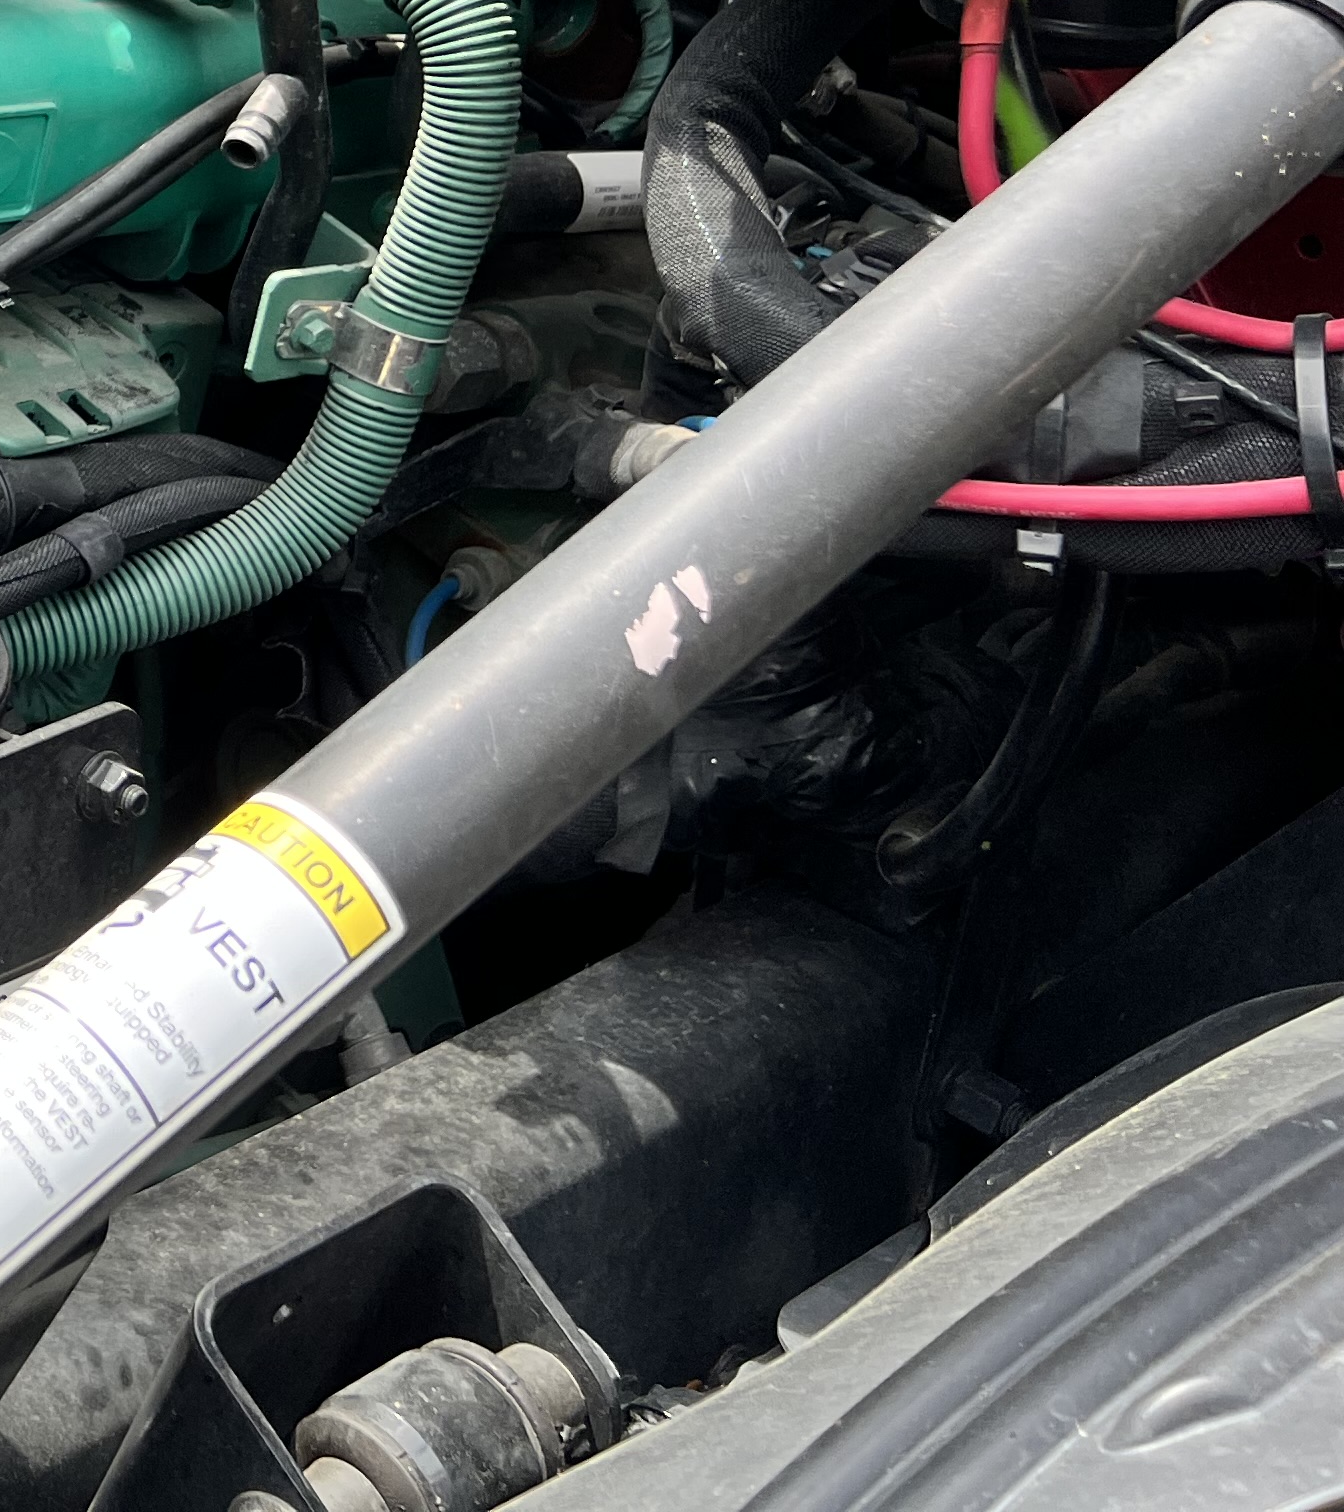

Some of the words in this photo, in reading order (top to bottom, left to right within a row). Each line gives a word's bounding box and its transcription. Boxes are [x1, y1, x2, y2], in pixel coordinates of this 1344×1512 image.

[223, 811, 356, 917] CAUTION
[188, 905, 286, 1015] VEST
[147, 1000, 206, 1078] Stability
[58, 1052, 112, 1119] steering
[95, 1063, 130, 1107] shaft
[126, 1105, 143, 1125] or
[14, 1099, 64, 1153] sensor
[47, 1097, 89, 1151] VEST
